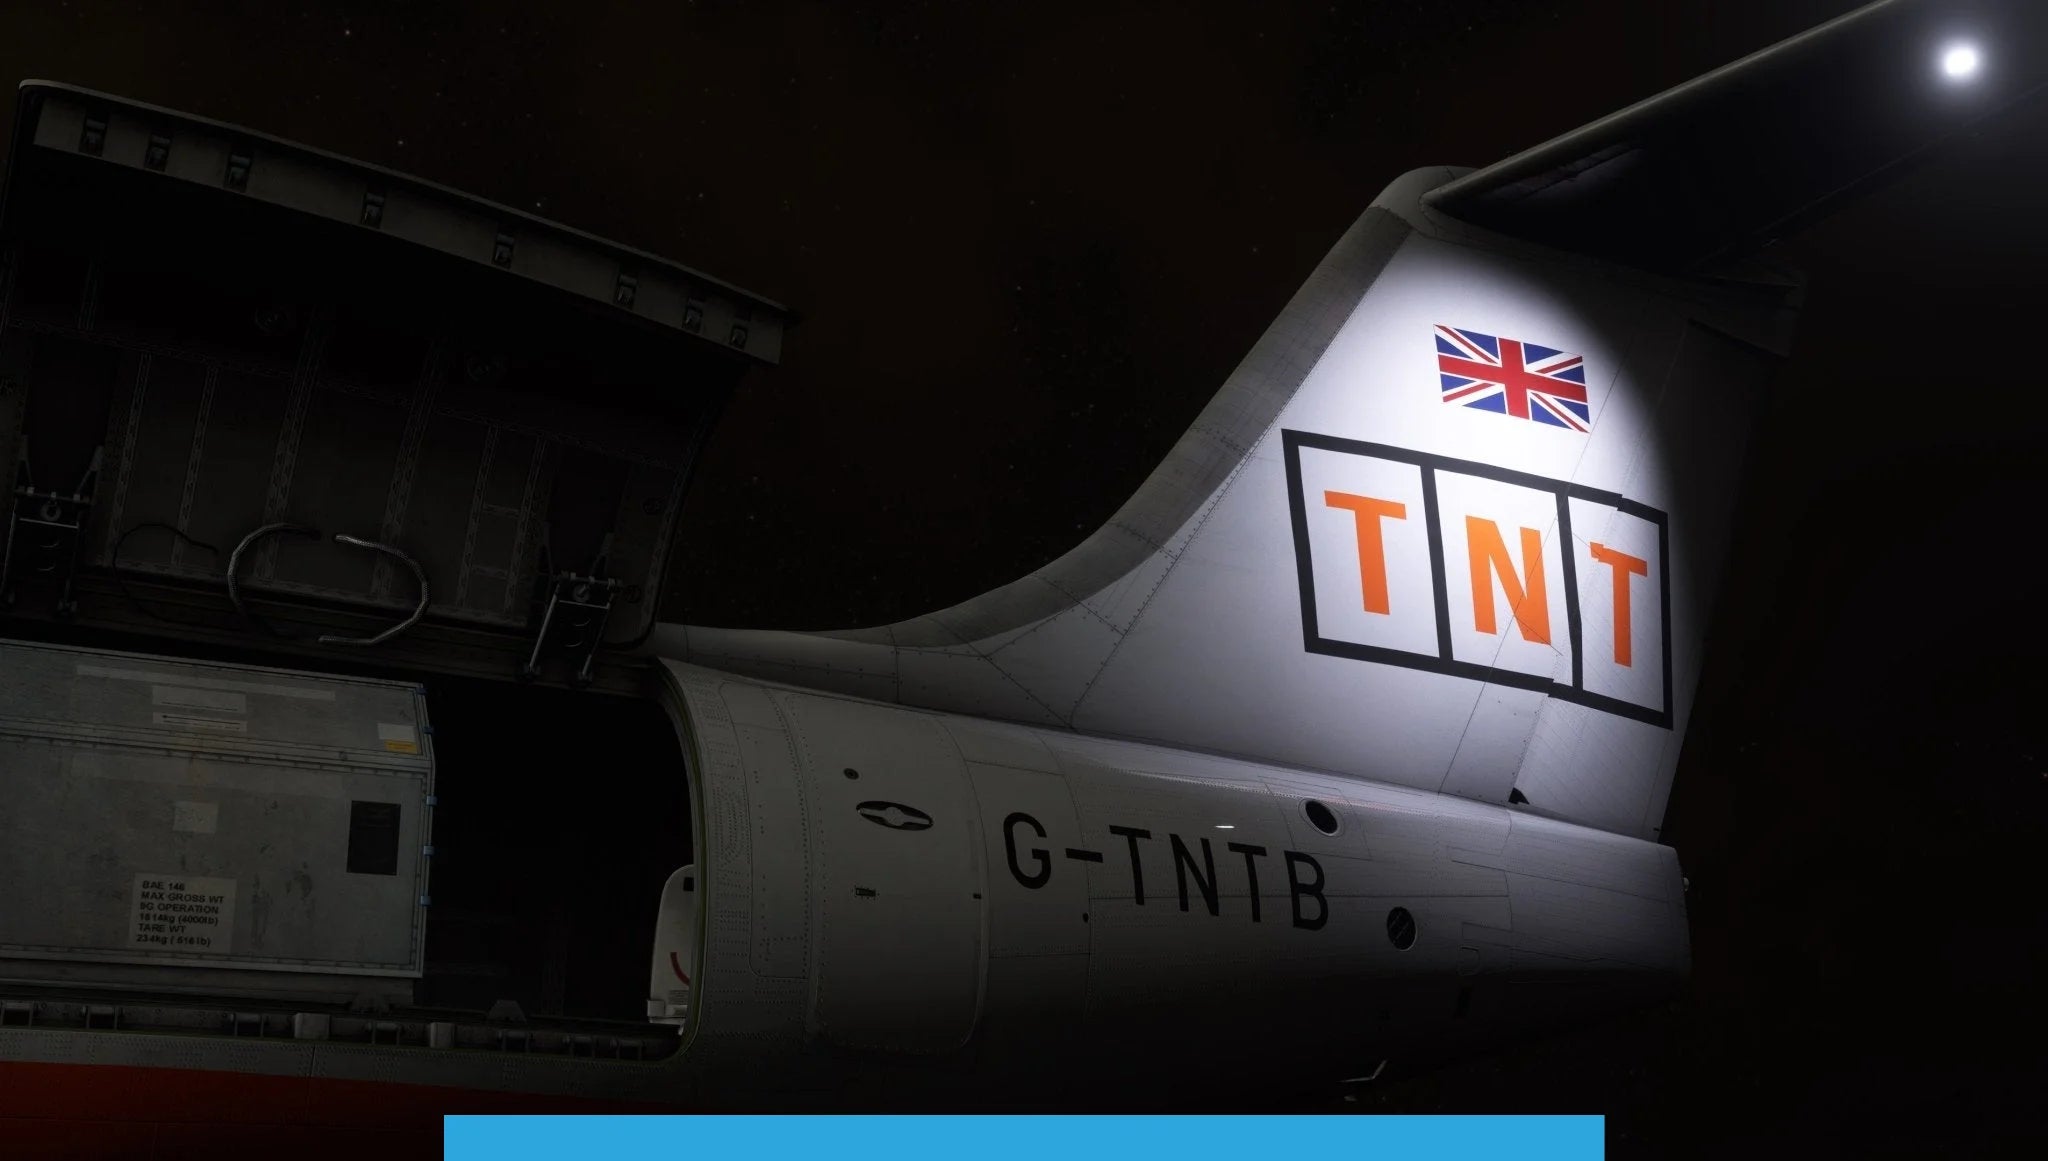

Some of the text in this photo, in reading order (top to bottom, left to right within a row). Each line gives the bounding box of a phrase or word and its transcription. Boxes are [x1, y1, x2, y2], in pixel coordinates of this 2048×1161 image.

[1324, 490, 1648, 668] TNT
[1003, 812, 1328, 931] G-TNTB
[142, 880, 185, 891] BAE 146
[141, 891, 225, 903] MAX GROSS WT
[157, 902, 219, 914] OPERATION
[139, 923, 186, 933] TARE WT
